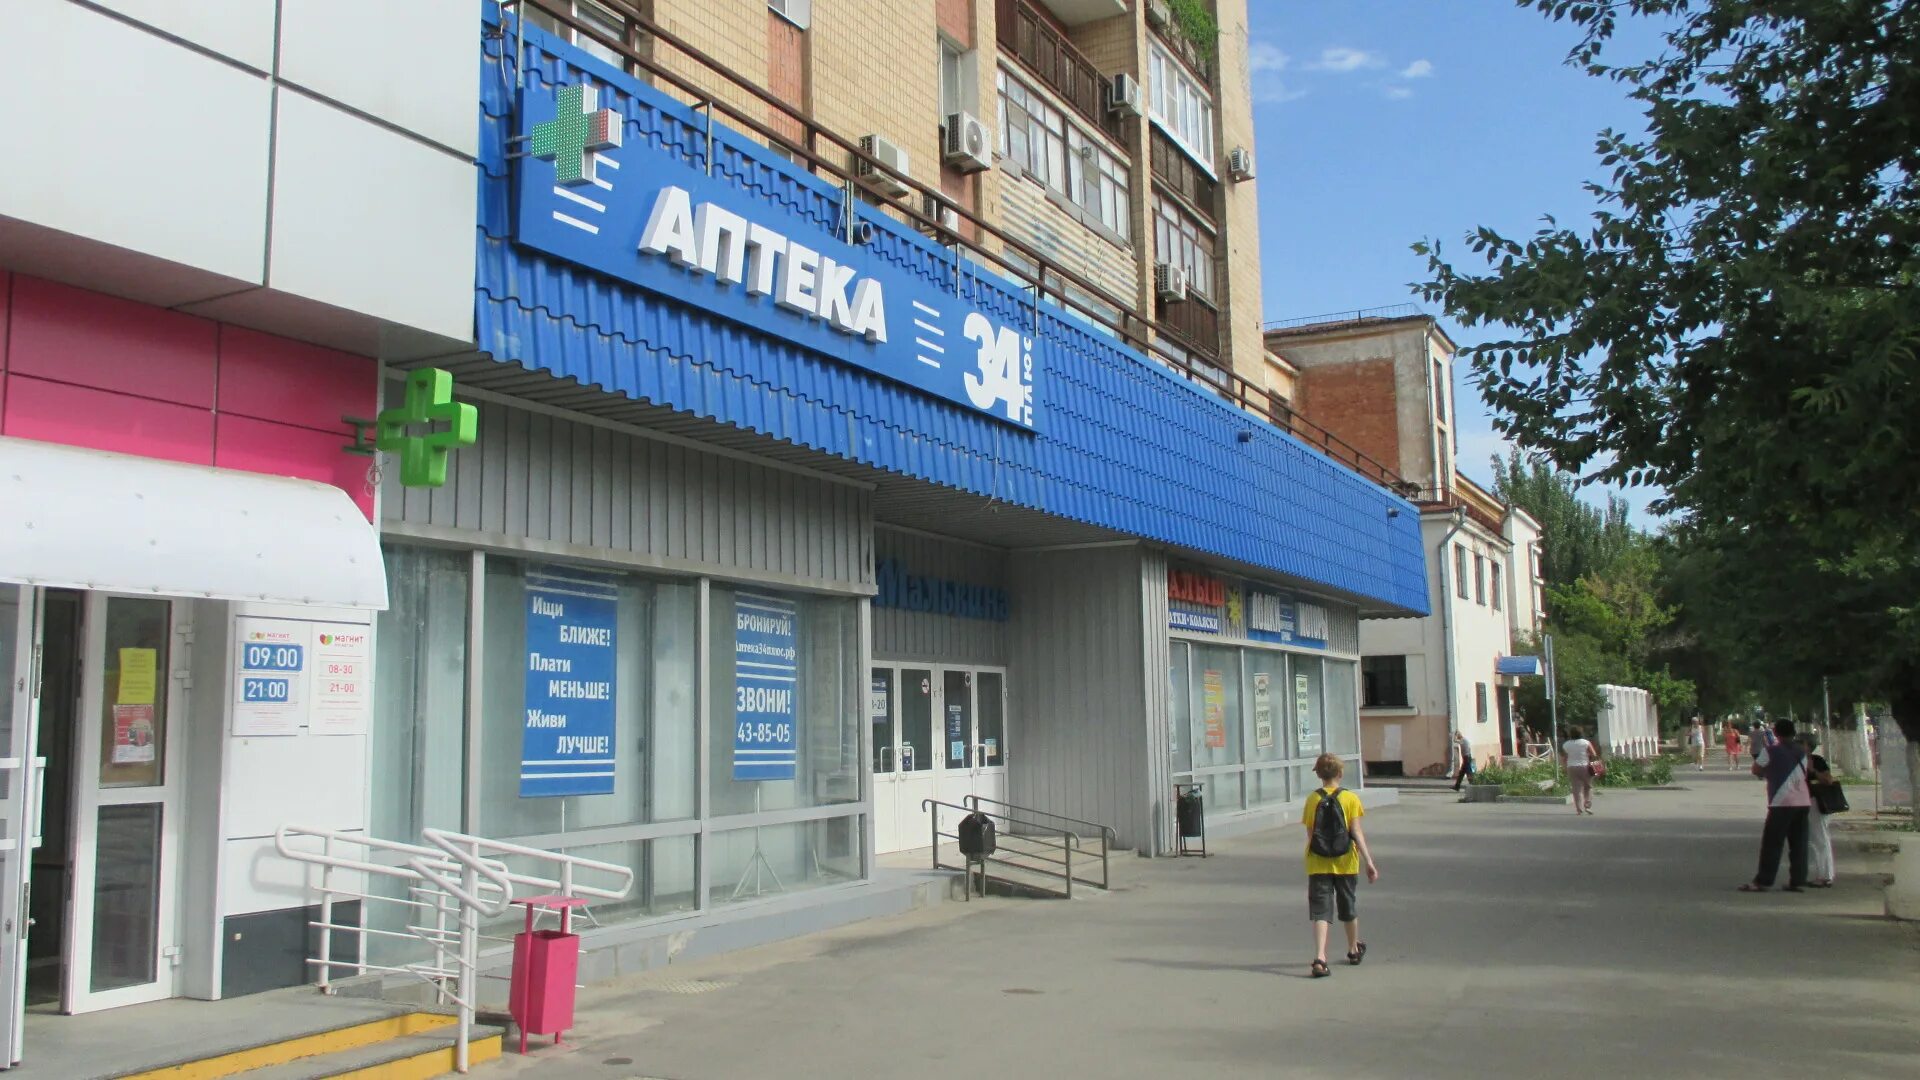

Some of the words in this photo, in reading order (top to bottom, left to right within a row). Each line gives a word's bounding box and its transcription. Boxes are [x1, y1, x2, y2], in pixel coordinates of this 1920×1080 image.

[637, 185, 888, 343] АПТЕКА
[964, 312, 1025, 421] 34
[1023, 336, 1033, 427] ПЛЮС
[532, 596, 564, 617] Ищи
[737, 613, 792, 637] БРОНИРУЙ!
[560, 625, 610, 647] БЛИЖЕ!
[249, 646, 298, 668] 09:00
[530, 653, 571, 673] Плати
[328, 664, 353, 674] 08-30
[247, 681, 286, 698] 21:00
[329, 683, 355, 693] 21-00
[549, 680, 610, 700] МЕНЬШЕ!
[736, 686, 791, 714] ЗВОНИ!
[527, 709, 566, 729] Живи
[737, 722, 790, 743] 43-85-05
[556, 735, 609, 754] ЛУЧШЕ!
